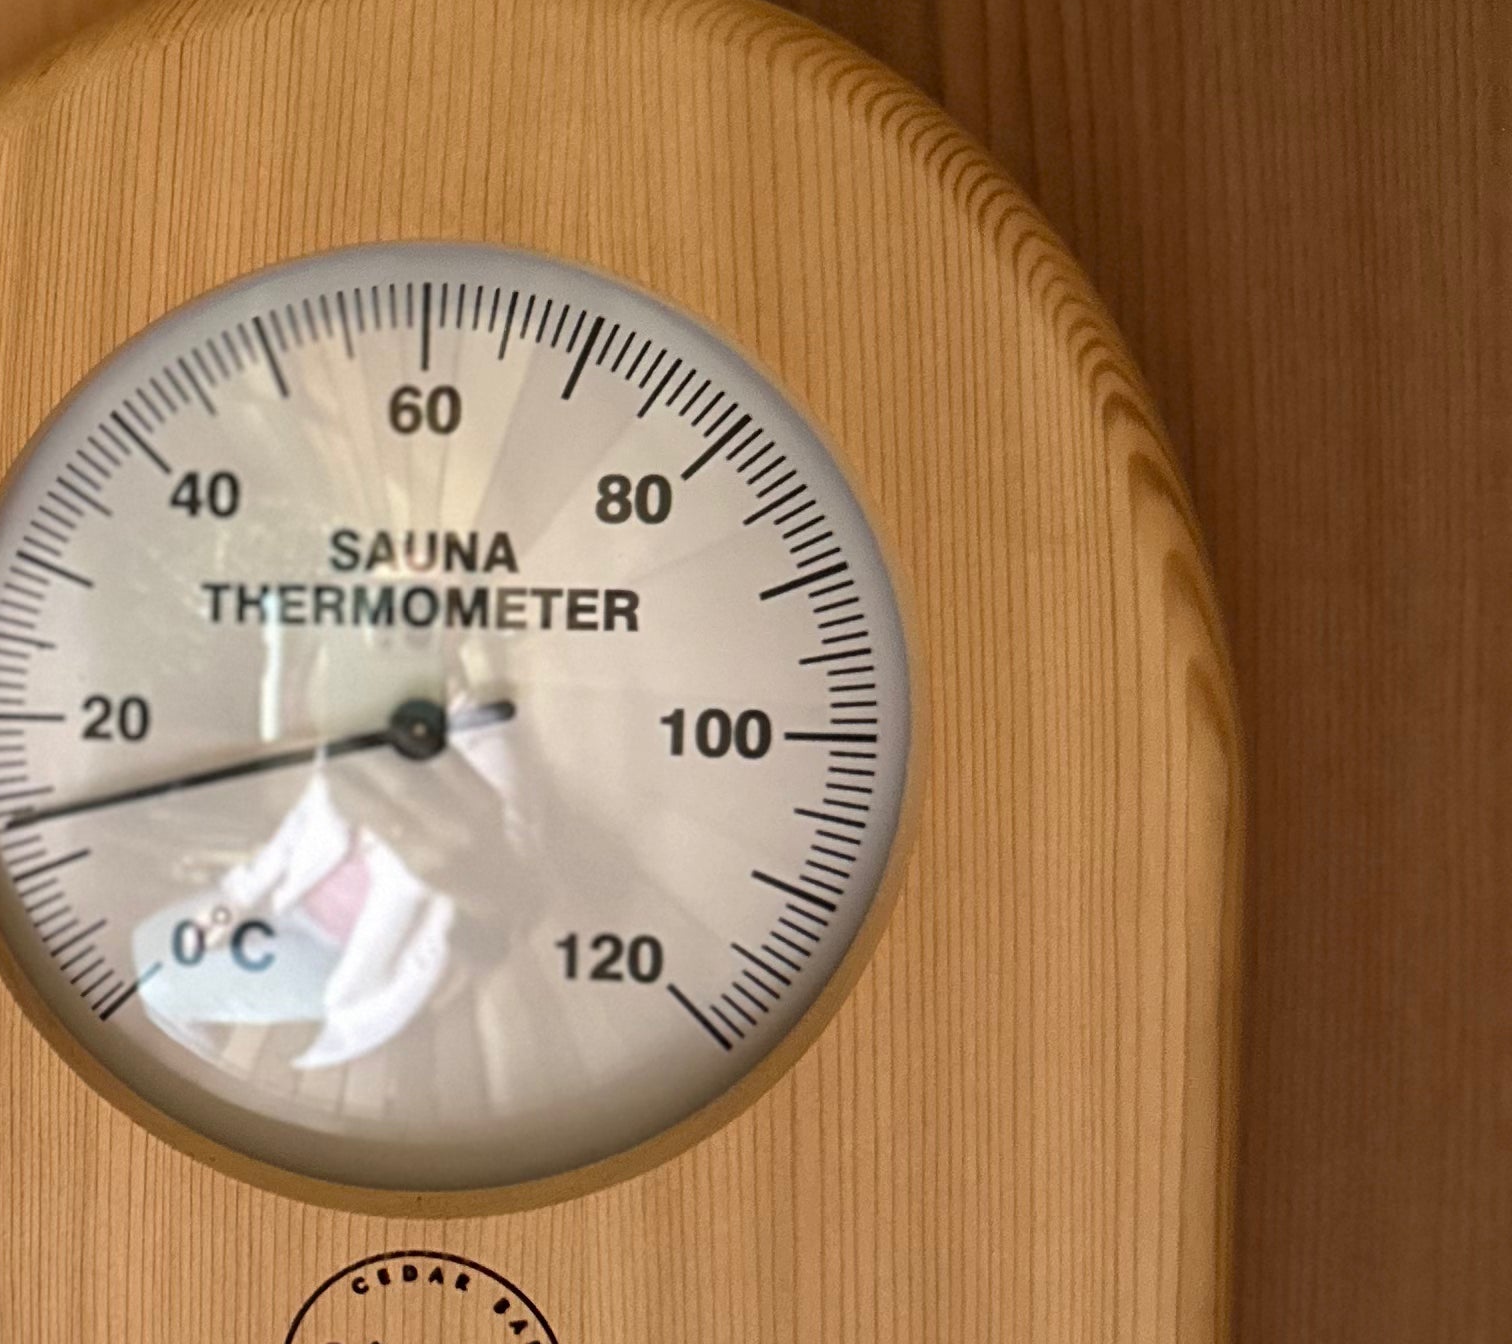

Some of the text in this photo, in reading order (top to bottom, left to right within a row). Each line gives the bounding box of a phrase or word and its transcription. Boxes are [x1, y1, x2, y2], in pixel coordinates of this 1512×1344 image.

[388, 386, 461, 435] 60
[170, 471, 240, 518] 40
[595, 475, 672, 525] 80
[329, 530, 519, 573] SAUNA
[200, 582, 640, 632] THERMOMETER
[80, 698, 150, 741] 20
[659, 709, 772, 758] 100
[555, 934, 663, 984] 120
[351, 1264, 471, 1294] CEDAR
